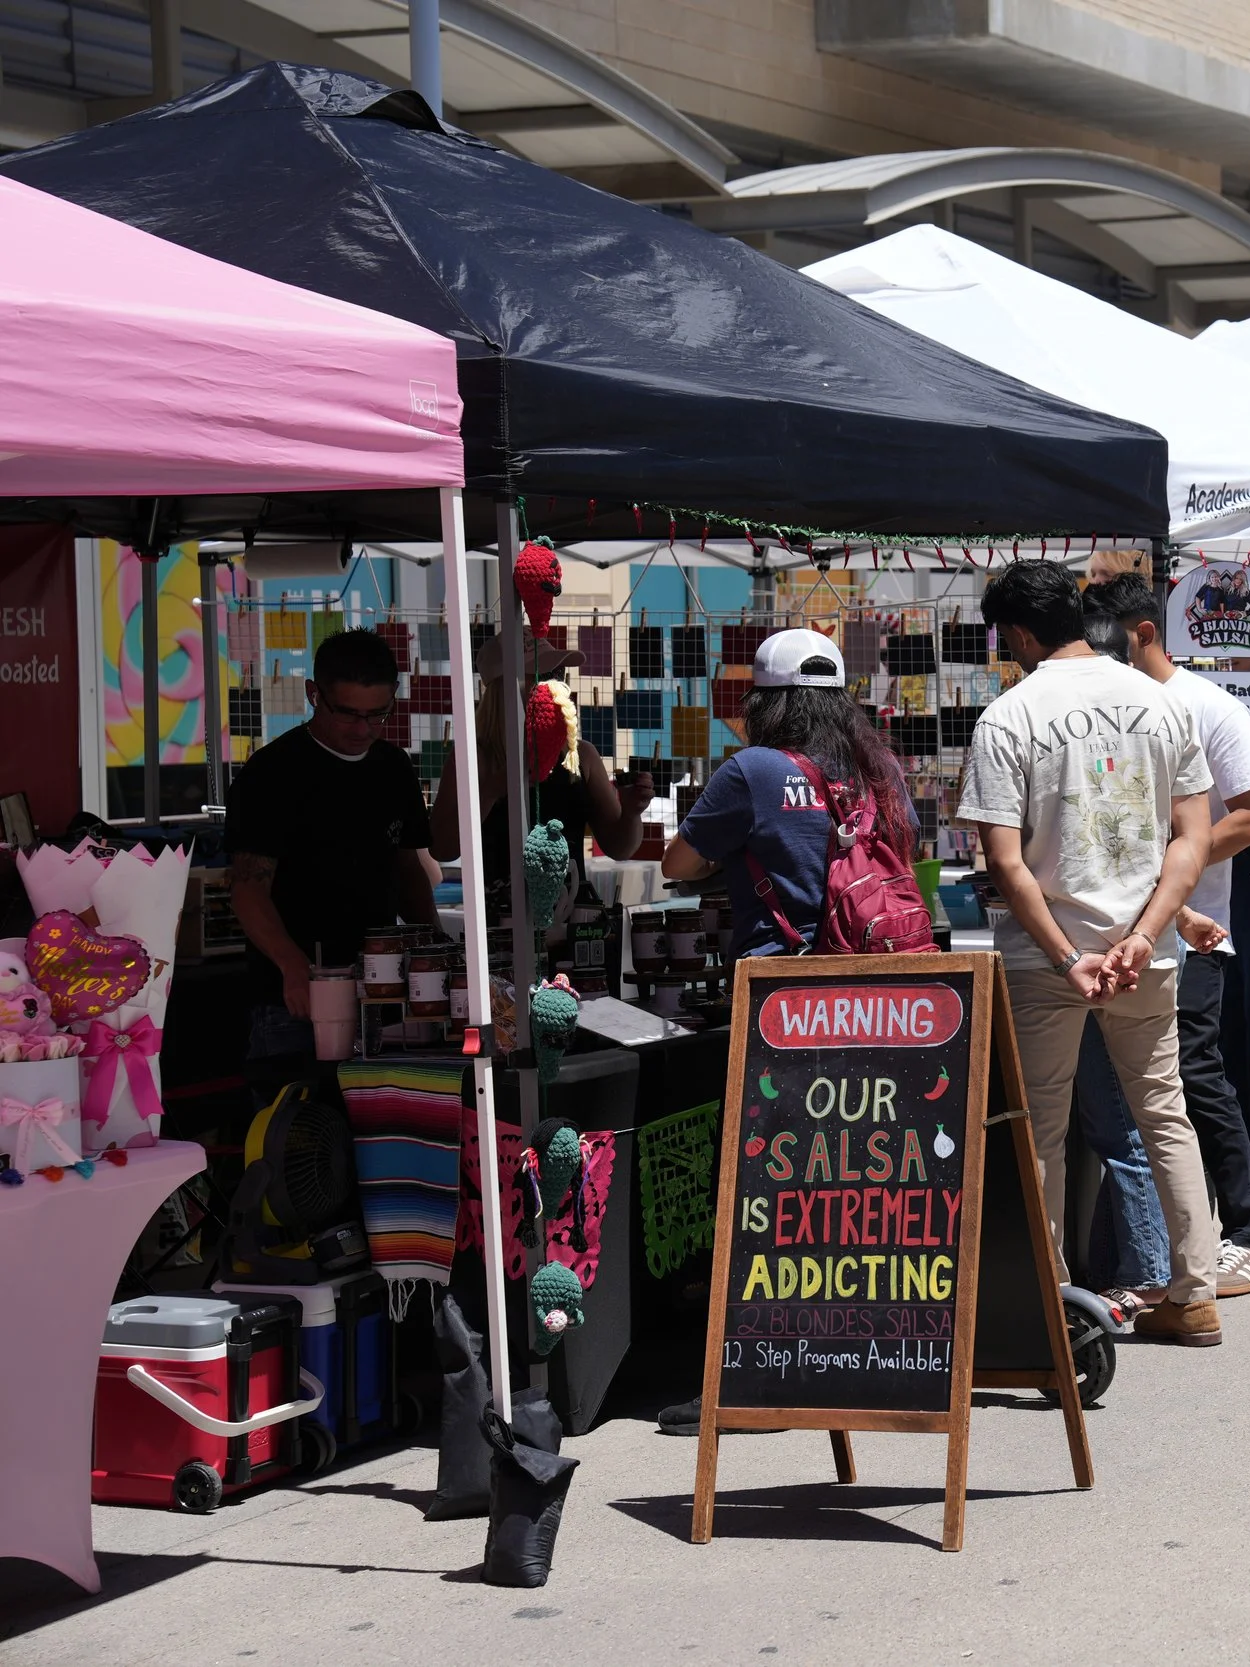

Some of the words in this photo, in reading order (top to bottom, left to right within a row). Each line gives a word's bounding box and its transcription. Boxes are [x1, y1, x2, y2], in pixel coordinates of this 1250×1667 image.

[0, 607, 46, 637] ESH
[1191, 625, 1200, 636] 2
[1030, 705, 1175, 764] MONZA
[1088, 741, 1120, 753] ITALY
[69, 935, 113, 955] HAPPY
[780, 997, 935, 1037] WARNING
[805, 1077, 897, 1123] OUR
[765, 1128, 928, 1182] SALSA
[741, 1196, 769, 1233] IS
[775, 1187, 962, 1246] EXTREMELY
[742, 1254, 953, 1301] ADDICTING
[737, 1306, 763, 1335] 2
[770, 1307, 875, 1336] BLONDES
[884, 1308, 952, 1337] SALSA
[723, 1341, 742, 1368] 12
[756, 1341, 792, 1379] Step
[797, 1339, 861, 1373] Programs
[866, 1339, 951, 1372] Available!
